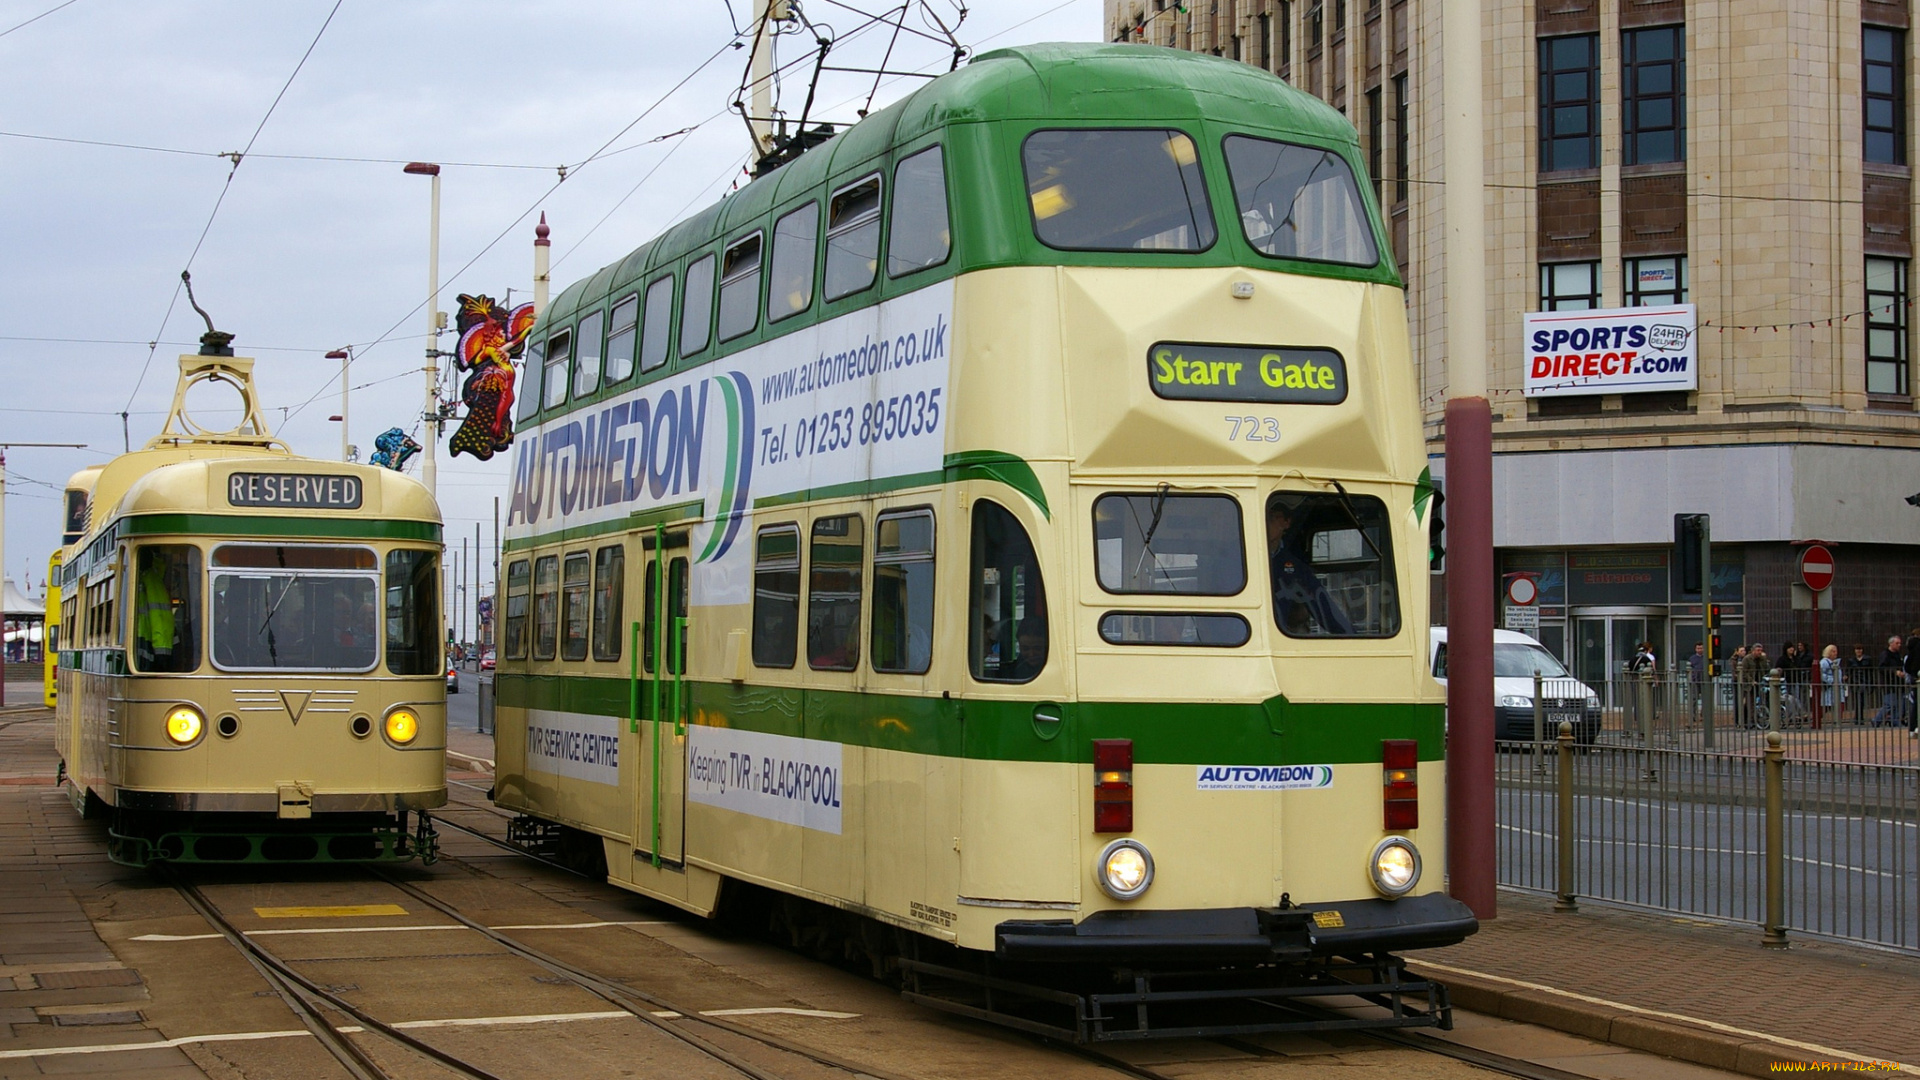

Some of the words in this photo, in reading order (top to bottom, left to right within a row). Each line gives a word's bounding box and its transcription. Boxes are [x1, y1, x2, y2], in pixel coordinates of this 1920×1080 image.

[1531, 325, 1646, 352] SPORTS
[1653, 328, 1684, 339] 24HR
[762, 313, 947, 405] www.automedon.co.uk
[1156, 349, 1242, 385] Starr
[1260, 353, 1336, 389] Gate
[761, 423, 788, 466] Tel.
[795, 406, 854, 458] 01253
[859, 387, 941, 445] 895035
[1225, 416, 1281, 442] 723
[507, 379, 709, 527] AUTOMEDON
[231, 474, 356, 504] RESERVED
[1584, 572, 1651, 583] Entrance
[528, 726, 543, 755] TVR
[544, 728, 580, 761] SERVICE
[582, 733, 618, 767] CENTRE
[689, 746, 727, 794] Keeping
[730, 752, 750, 790] TVR
[753, 766, 760, 791] in
[762, 757, 840, 808] BLACKPOOL
[1198, 766, 1314, 781] AUTOMEDON
